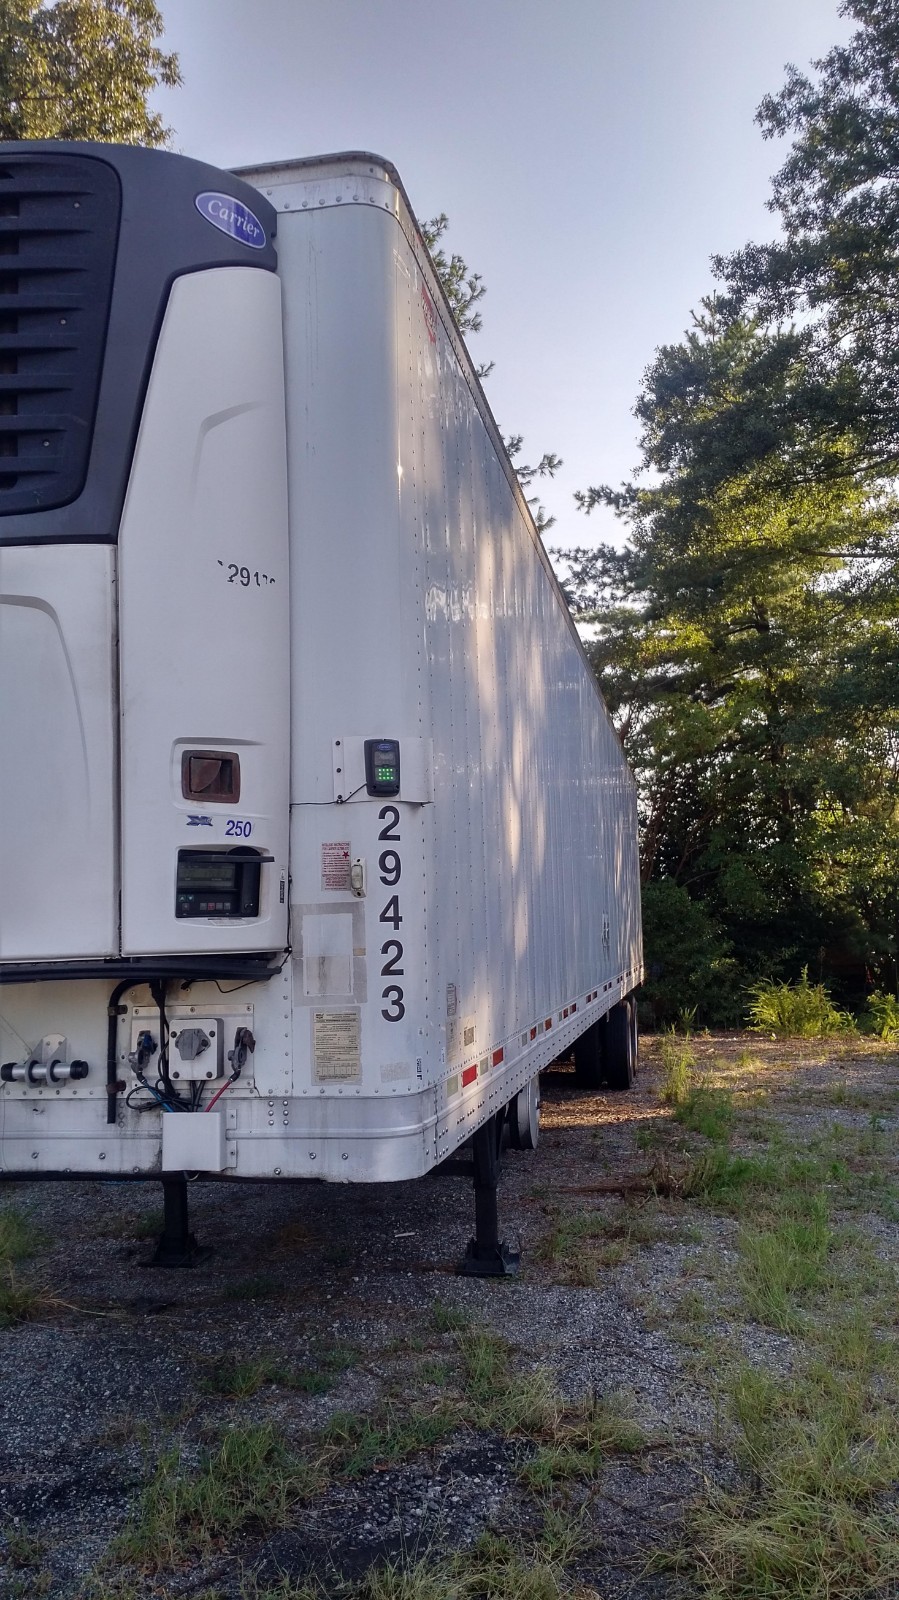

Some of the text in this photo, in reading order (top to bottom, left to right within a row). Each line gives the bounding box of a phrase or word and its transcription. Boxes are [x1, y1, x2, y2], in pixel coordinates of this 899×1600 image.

[208, 200, 260, 238] Carrier
[225, 819, 252, 838] 250
[378, 805, 405, 1022] 29423
